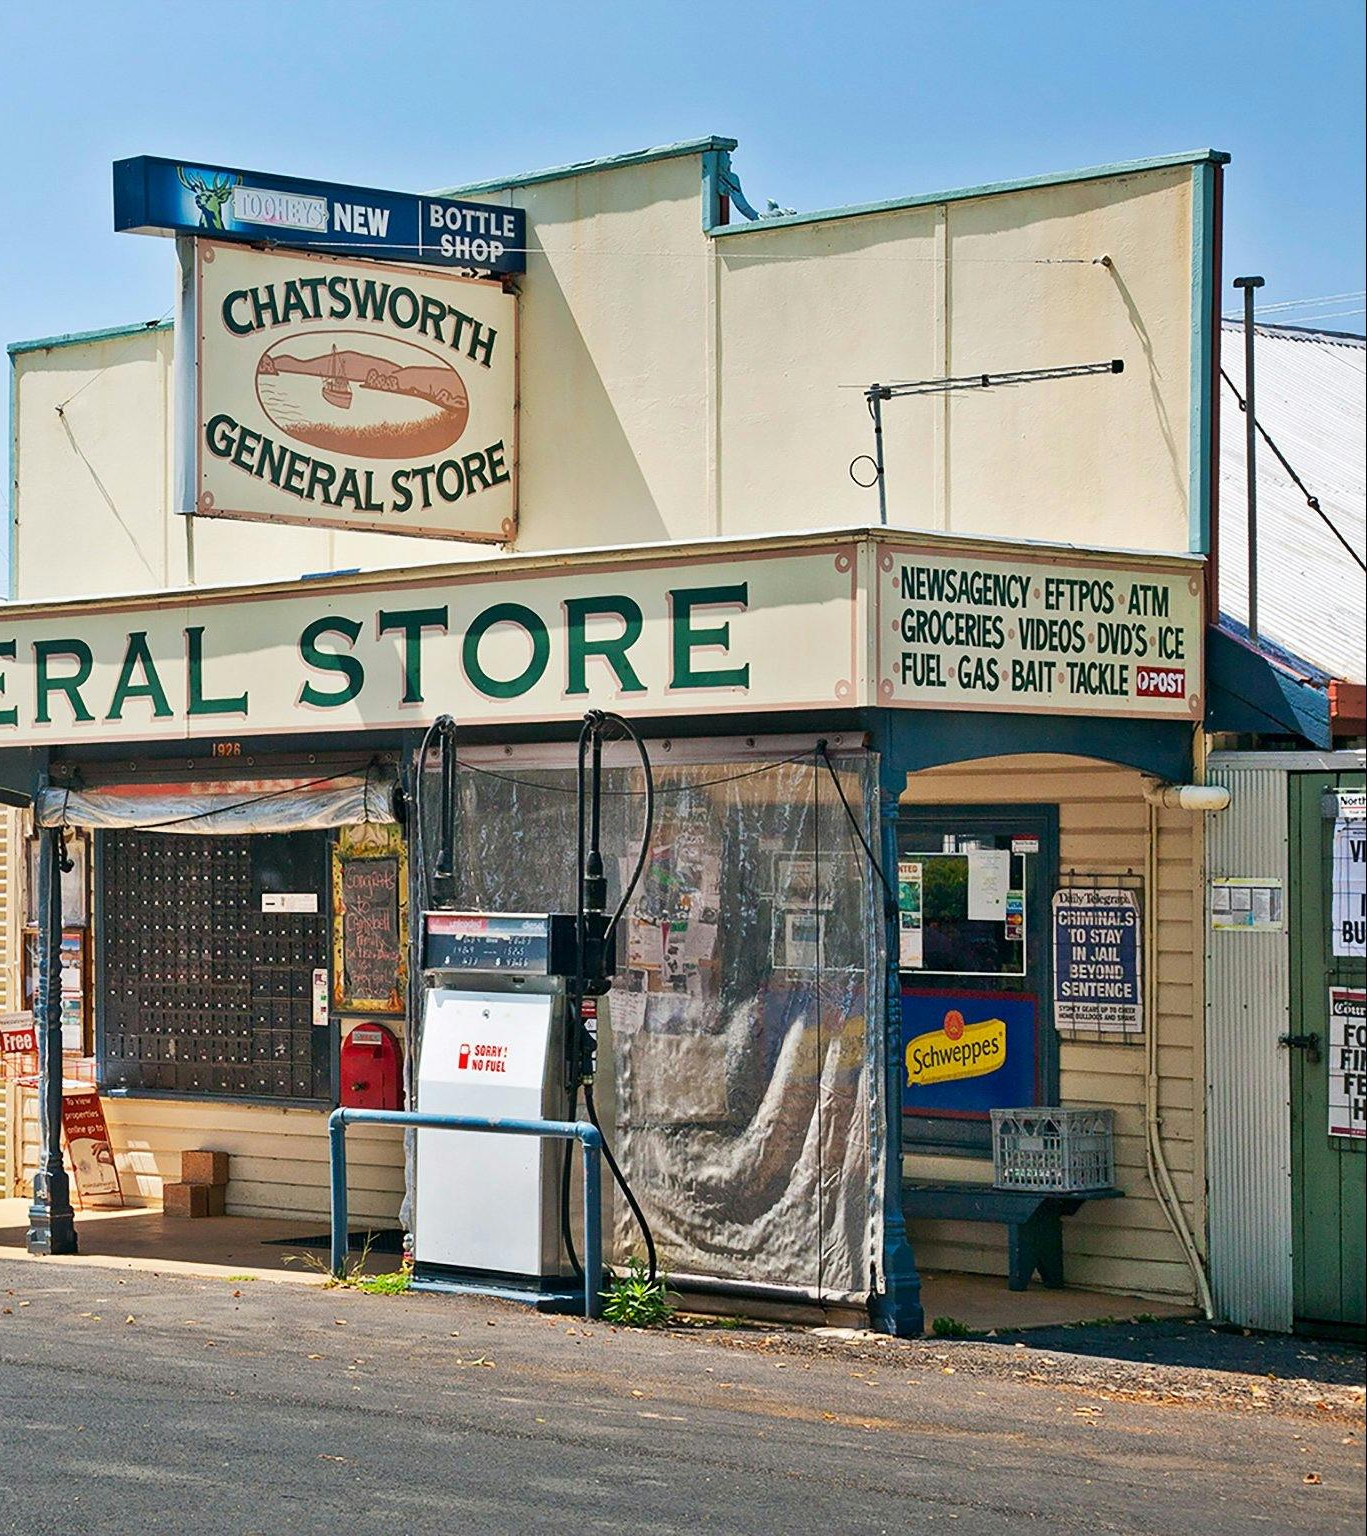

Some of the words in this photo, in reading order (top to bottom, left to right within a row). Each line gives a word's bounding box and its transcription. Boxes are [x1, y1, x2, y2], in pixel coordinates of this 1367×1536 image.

[243, 194, 324, 226] TOOHEYS
[334, 202, 390, 238] NEW
[429, 204, 516, 239] BOTTLE
[440, 234, 505, 264] SHOP
[222, 276, 498, 369] CHATSWORTH
[205, 413, 384, 513] GENERAL
[391, 440, 511, 513] STORE
[901, 566, 1031, 609] NEWSAGENCY
[1045, 577, 1115, 614] EFTPOS
[1127, 584, 1169, 617] ATM
[298, 581, 750, 707] STORE
[901, 608, 1005, 650] GROCERIES
[1018, 617, 1086, 654] VIDEOS
[1097, 622, 1148, 657] DVD'S
[1158, 626, 1185, 659] ICE
[901, 652, 947, 687] FUEL
[957, 655, 1000, 692] GAS
[1011, 659, 1057, 692] BAIT
[1066, 662, 1129, 696] TACKLE
[1149, 671, 1184, 693] POST
[1058, 910, 1134, 927] CRIMINALS
[1068, 928, 1087, 943] TO
[1090, 929, 1124, 944] STAY
[1072, 946, 1087, 961] IN
[1090, 946, 1121, 962] JAIL
[1069, 964, 1124, 979] BEYOND
[1061, 981, 1133, 998] SENTENCE
[3, 1032, 33, 1052] Free
[472, 1059, 484, 1071] NO
[485, 1060, 506, 1072] FUEL
[913, 1037, 999, 1075] Schweppes
[65, 1098, 75, 1106] To
[76, 1097, 91, 1106] view
[65, 1111, 99, 1121] properties
[67, 1125, 87, 1134] online
[87, 1125, 96, 1135] go
[96, 1124, 103, 1132] to
